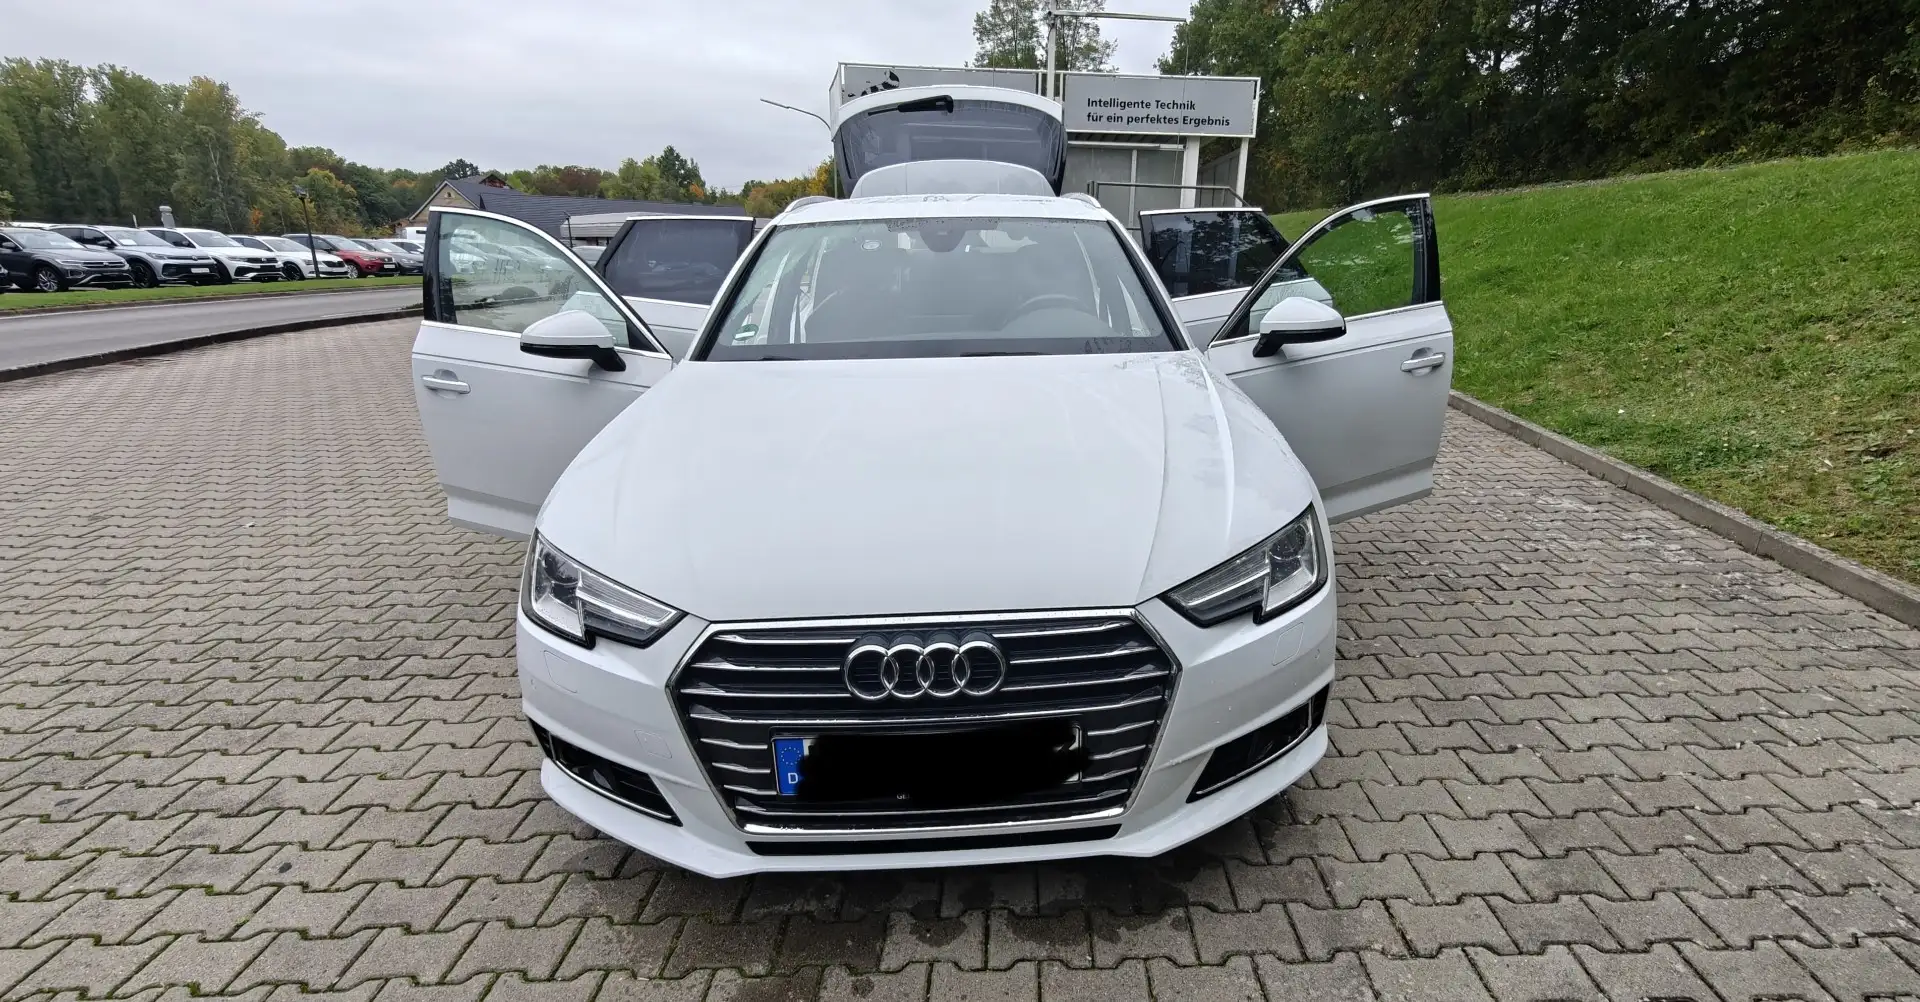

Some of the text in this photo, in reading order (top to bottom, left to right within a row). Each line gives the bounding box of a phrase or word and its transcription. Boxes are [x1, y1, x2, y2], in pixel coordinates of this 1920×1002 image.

[1087, 98, 1196, 110] Intelligente Technik
[1086, 112, 1230, 127] für ein perfektes Ergebnis
[787, 772, 799, 784] D
